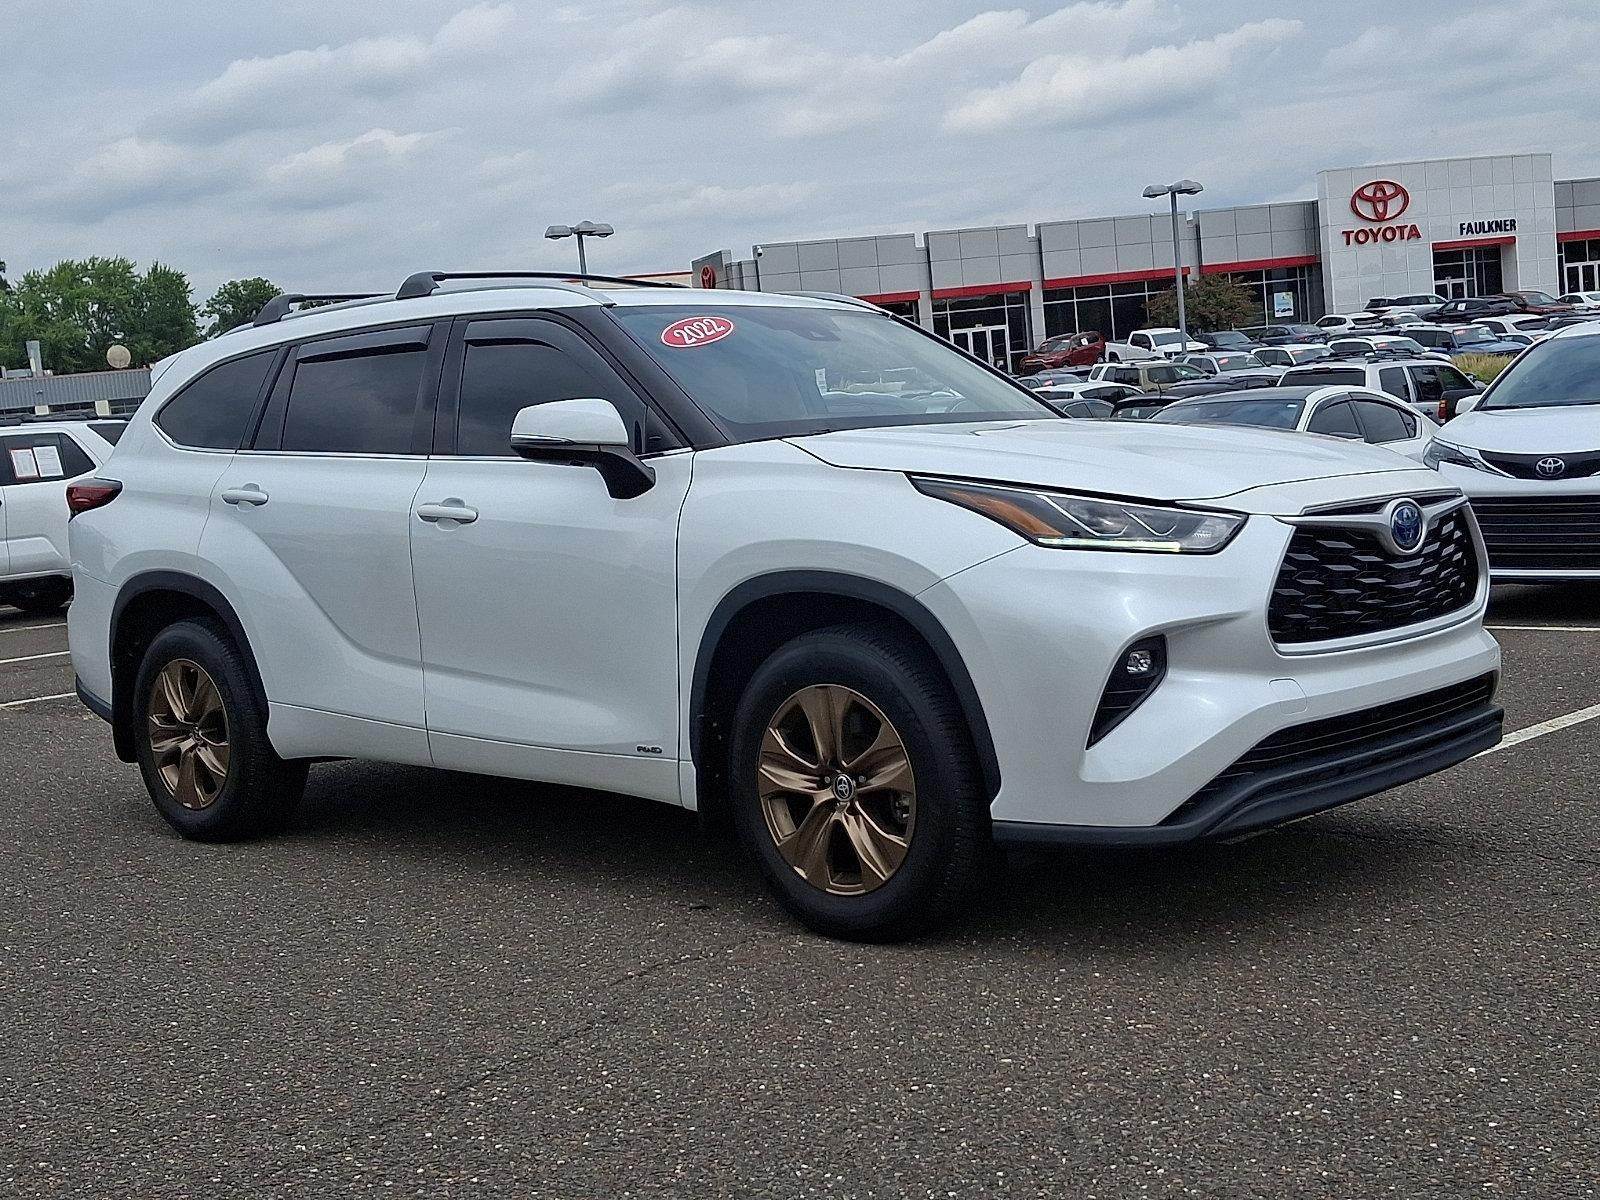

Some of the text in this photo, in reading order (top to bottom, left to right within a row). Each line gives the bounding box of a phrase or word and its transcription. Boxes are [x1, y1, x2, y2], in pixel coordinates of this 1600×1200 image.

[1342, 224, 1422, 246] TOYOTA
[1459, 219, 1517, 236] FAULKNER
[673, 318, 726, 344] 2022
